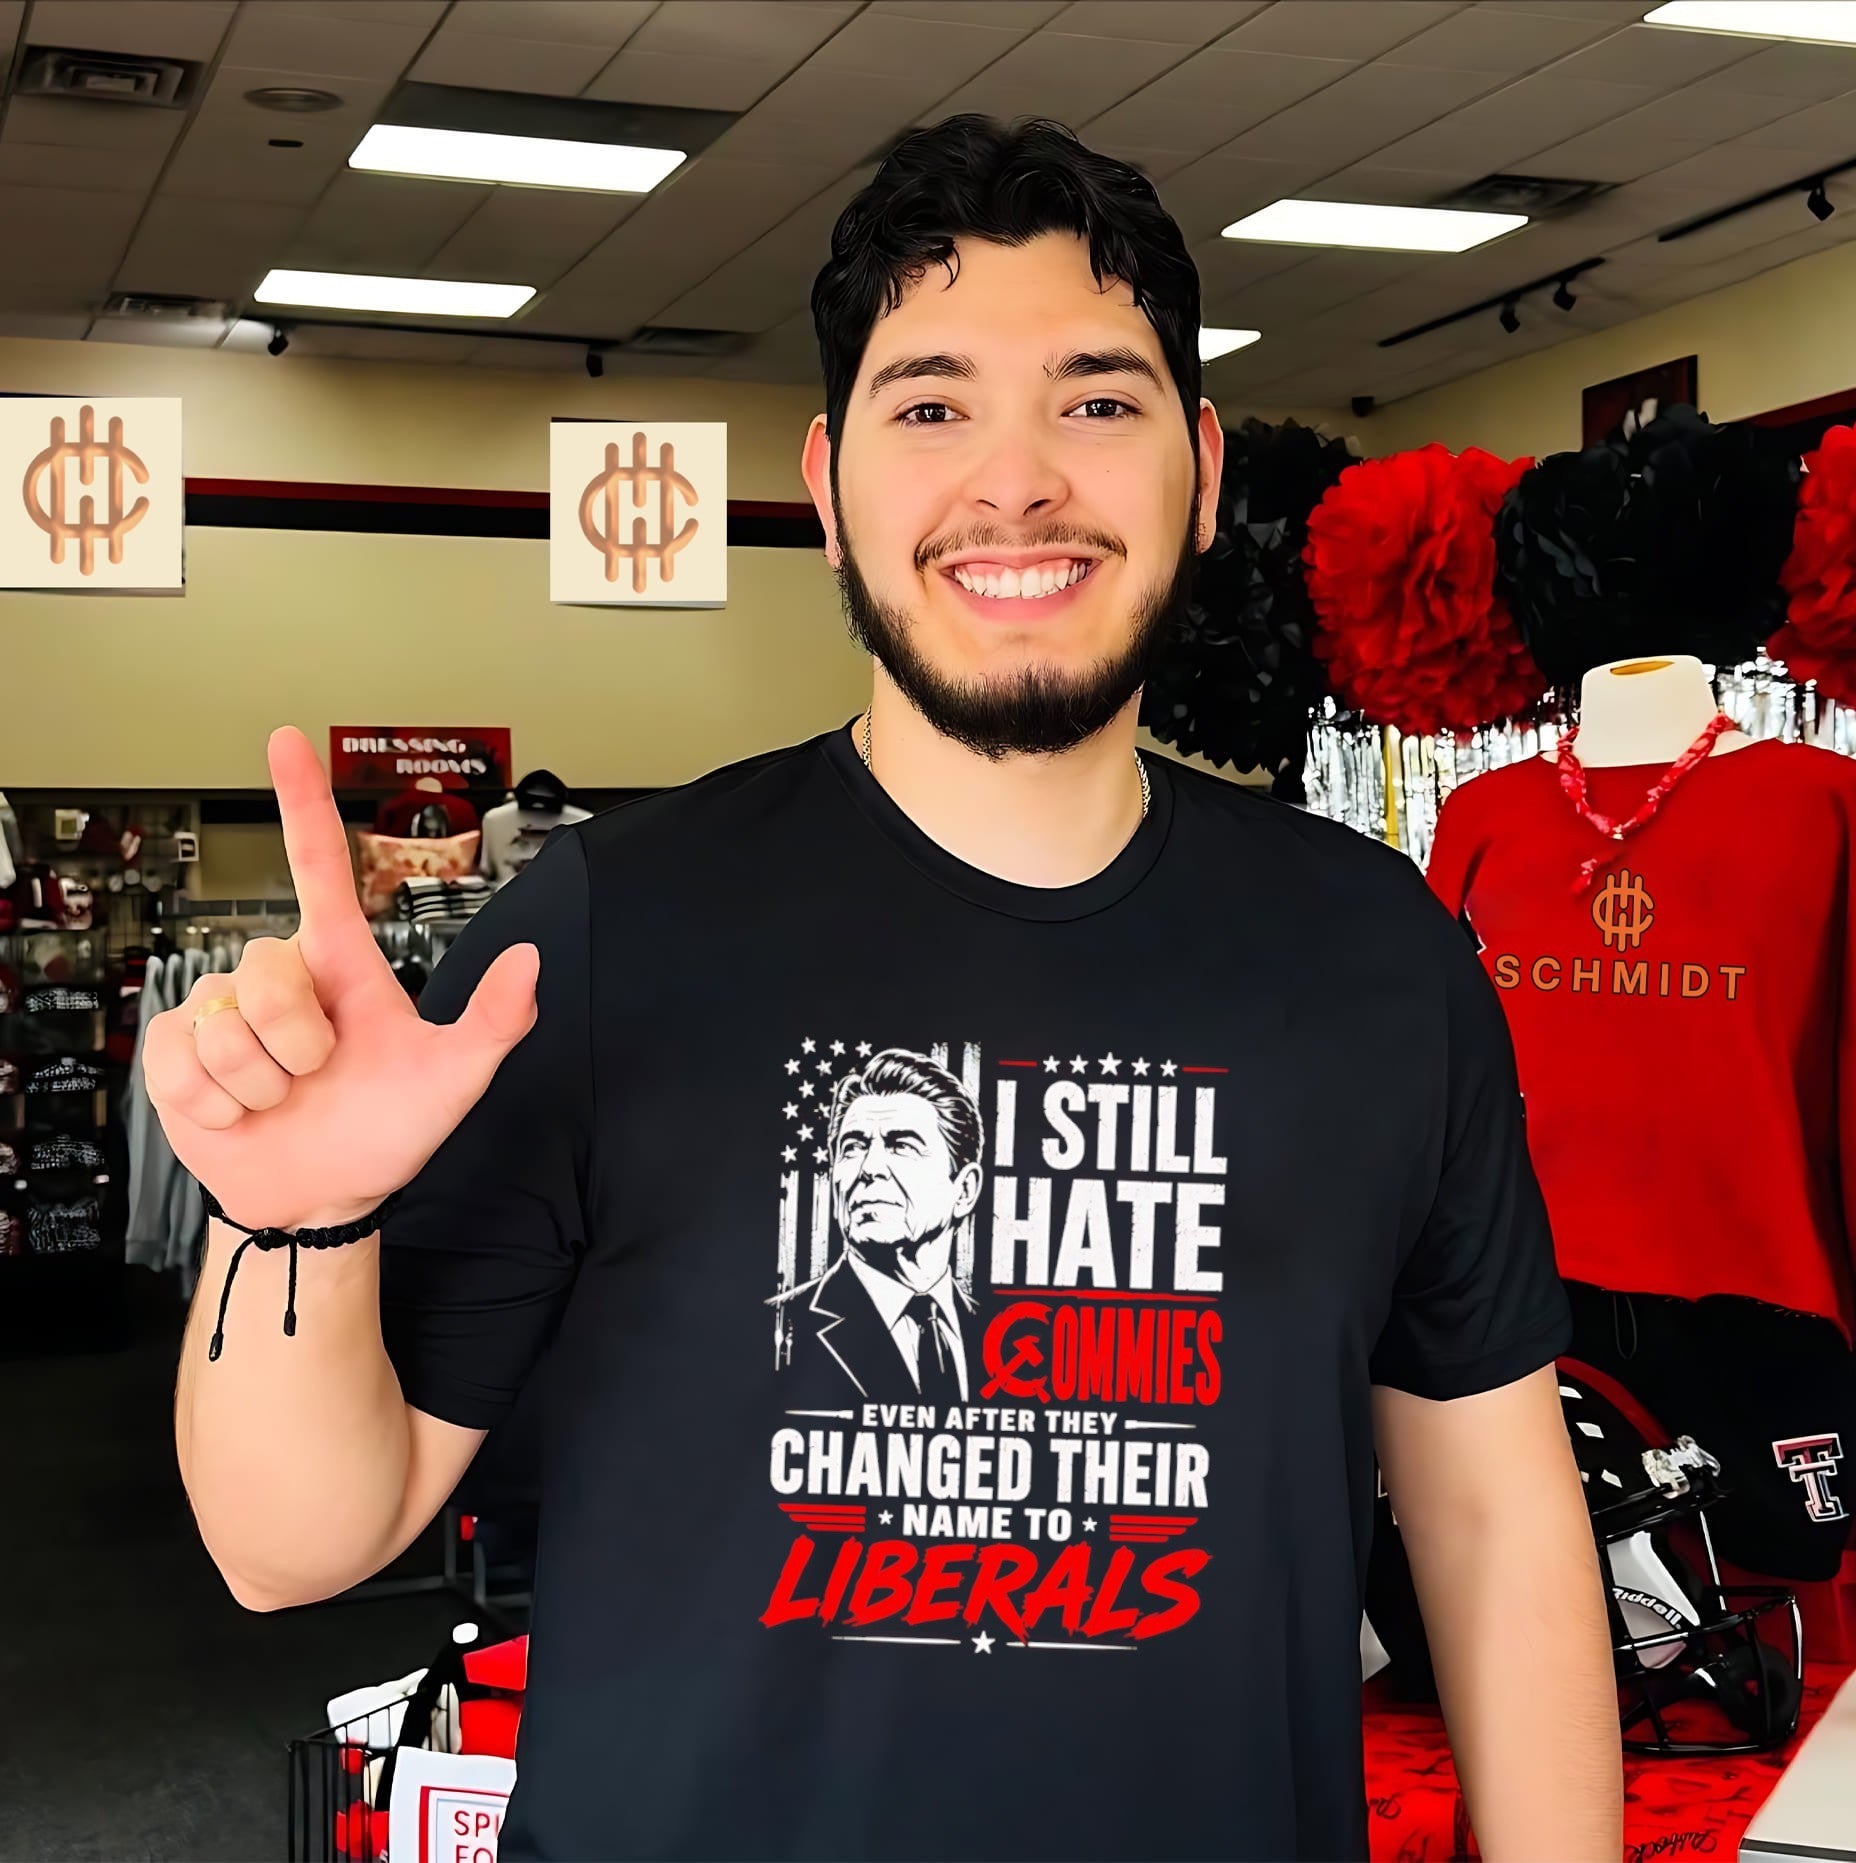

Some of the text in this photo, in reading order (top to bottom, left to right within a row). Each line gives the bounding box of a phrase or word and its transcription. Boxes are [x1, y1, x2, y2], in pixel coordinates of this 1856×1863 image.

[342, 737, 467, 753] DRESSING
[396, 758, 486, 775] ROOMS
[1494, 953, 1747, 1000] SCHMIDT
[994, 1079, 1228, 1175] I STILL
[990, 1175, 1226, 1292] HATE
[980, 1302, 1224, 1406] COMMIES
[862, 1404, 1118, 1436] EVEN AFTER THEY
[769, 1428, 1210, 1508] CHANGED THEIR
[902, 1504, 1073, 1542] NAME TO
[759, 1535, 1213, 1645] LIBERALS
